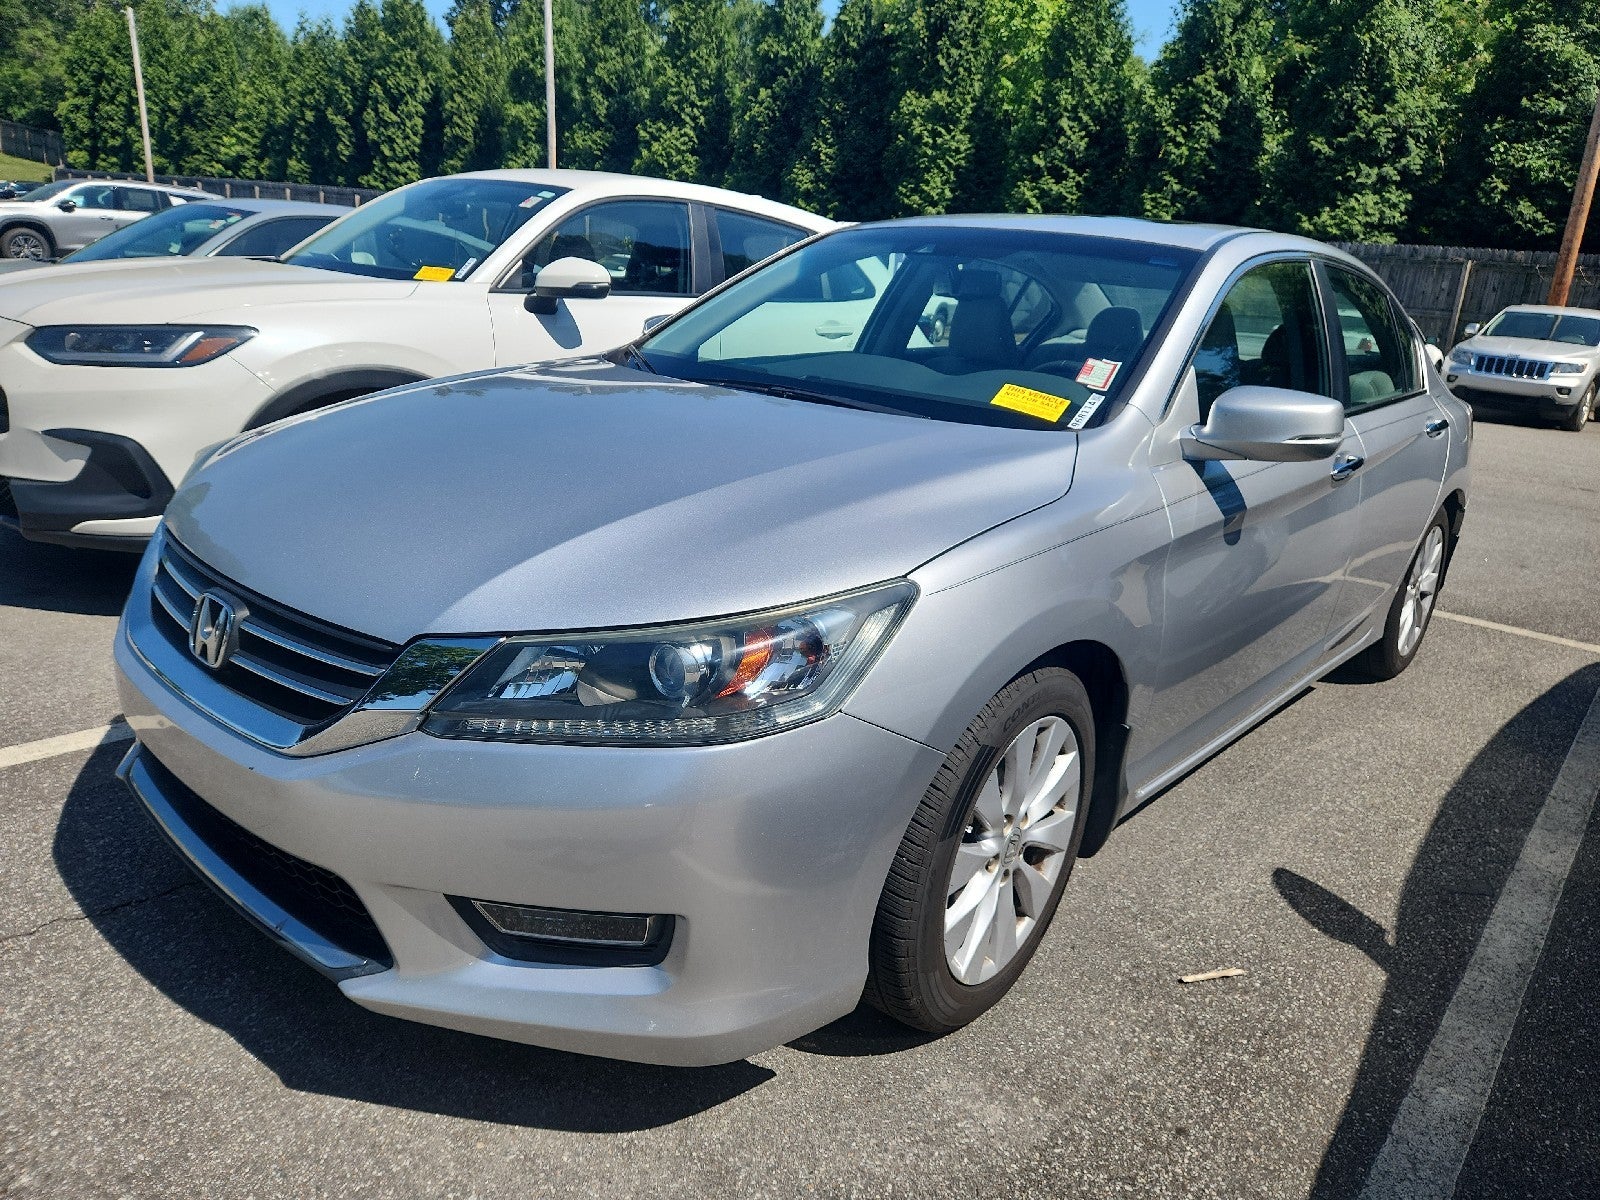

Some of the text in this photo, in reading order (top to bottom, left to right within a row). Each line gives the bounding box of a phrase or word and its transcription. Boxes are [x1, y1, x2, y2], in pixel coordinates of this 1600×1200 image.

[1006, 385, 1067, 406] THIS VEHICLE
[1021, 394, 1039, 403] FOR
